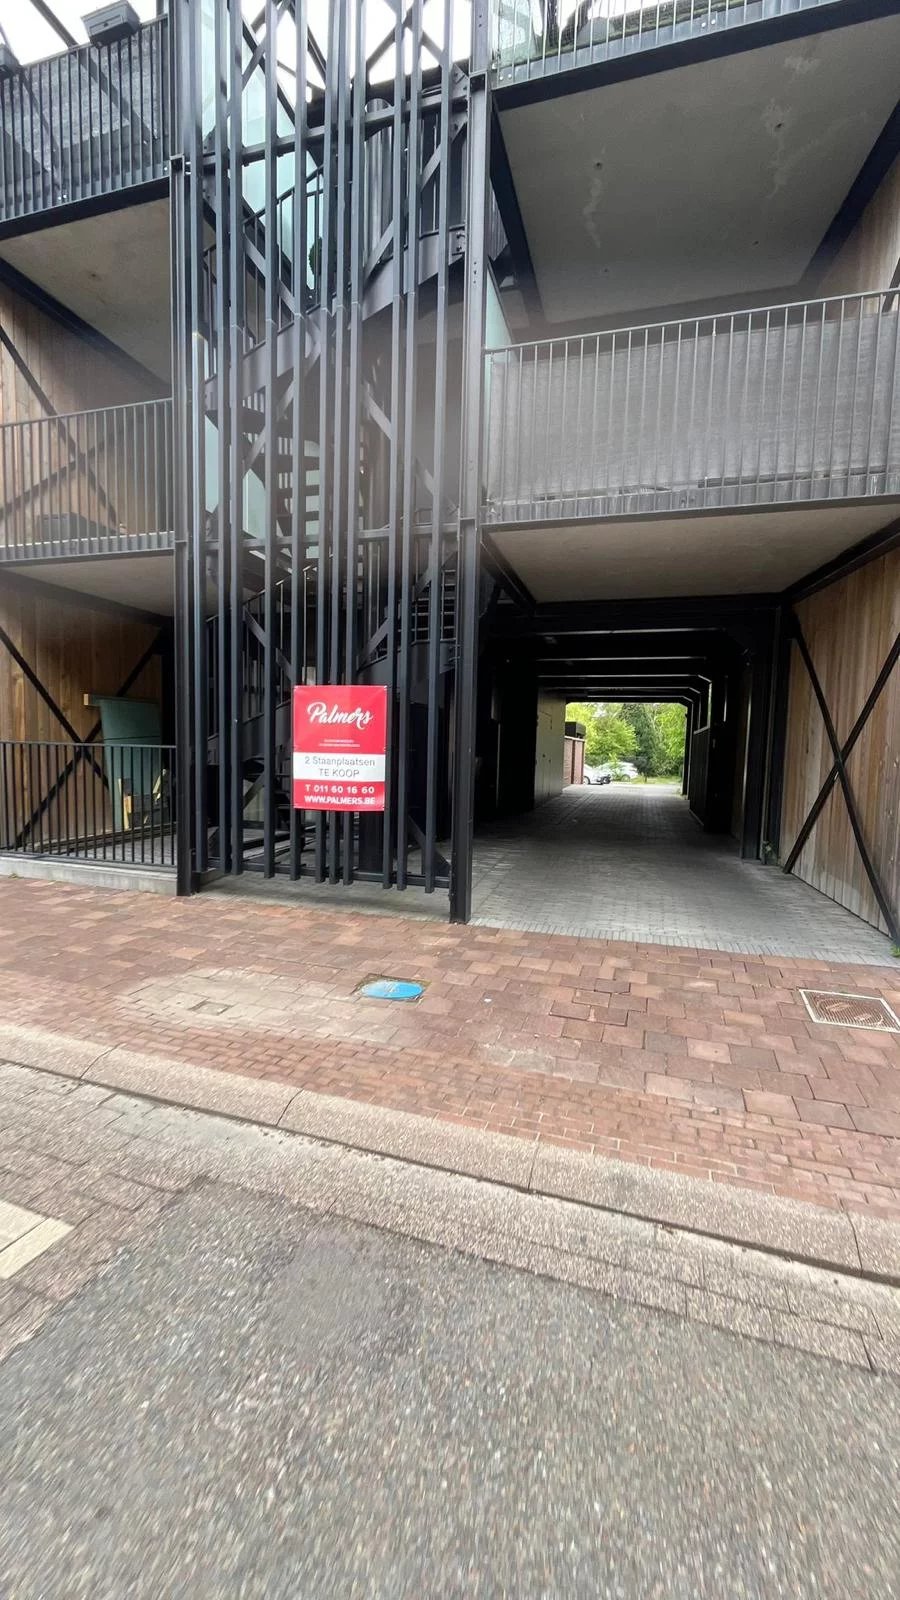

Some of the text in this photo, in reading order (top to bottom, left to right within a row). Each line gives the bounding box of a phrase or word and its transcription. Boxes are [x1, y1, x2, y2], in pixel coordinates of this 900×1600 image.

[307, 702, 372, 730] Palmers
[305, 756, 375, 766] 2 Staanplaatsen
[319, 769, 360, 778] TE KOOP
[305, 784, 311, 793] T
[314, 784, 328, 793] 011
[347, 785, 358, 793] 16
[361, 785, 375, 793] 60
[304, 796, 376, 804] WWW.PALMERS.BE
